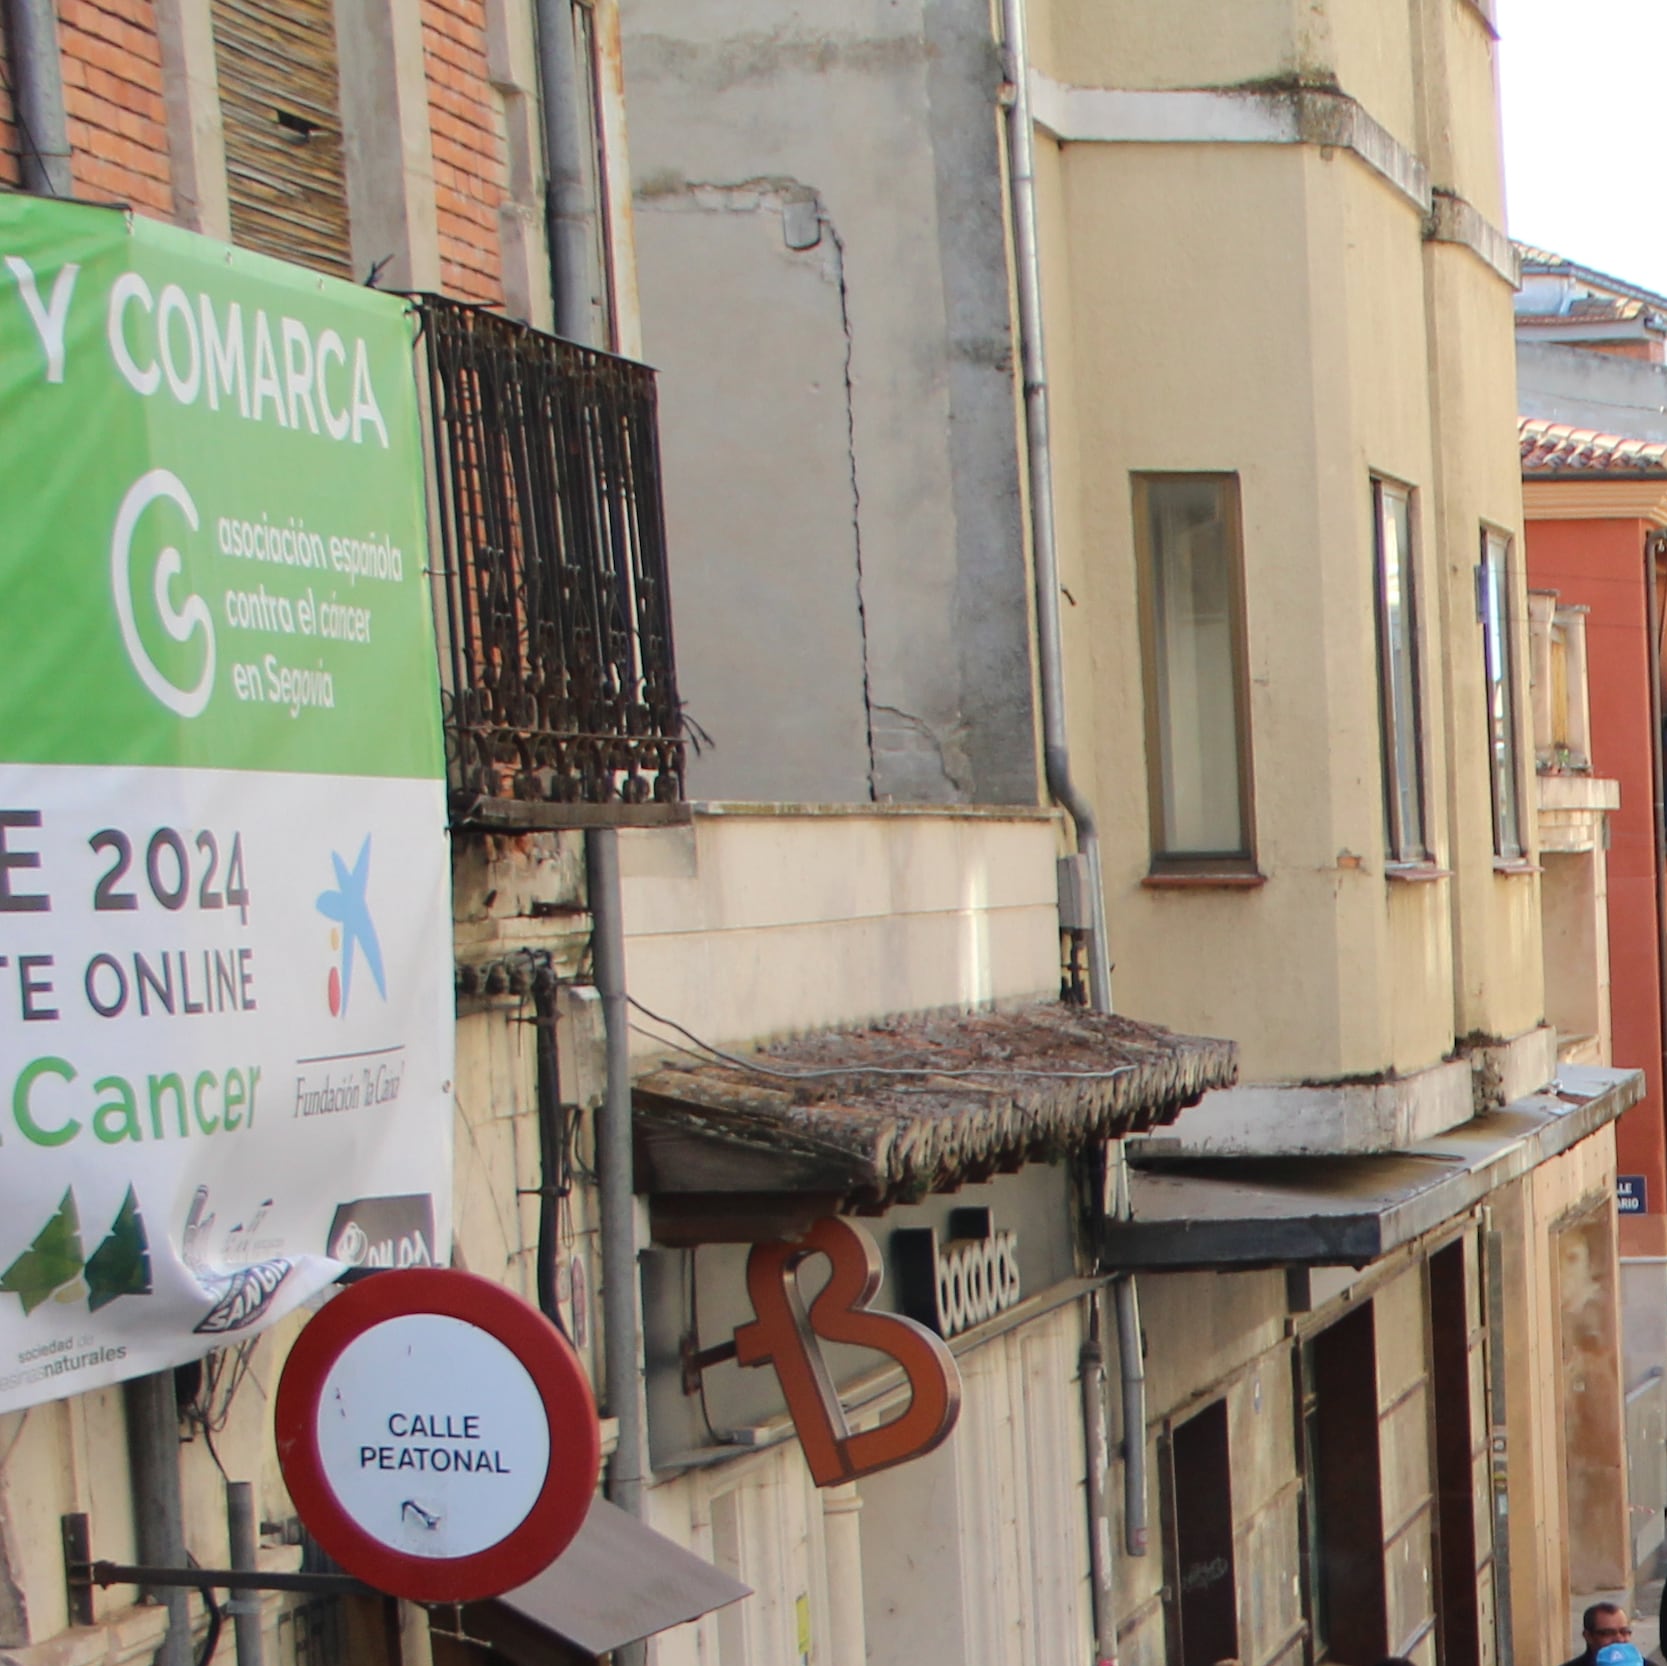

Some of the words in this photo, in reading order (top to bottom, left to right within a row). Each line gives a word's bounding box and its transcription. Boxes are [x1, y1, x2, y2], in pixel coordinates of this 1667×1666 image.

[5, 255, 80, 383] Y
[107, 270, 389, 449] COMARCA
[218, 511, 328, 569] asociación
[329, 531, 403, 587] española
[225, 583, 296, 634] contra
[297, 586, 317, 635] el
[319, 590, 371, 643] cáncer
[232, 661, 264, 702] en
[264, 652, 335, 719] Segovia
[89, 826, 250, 926] 2024
[0, 951, 60, 1022] E
[84, 947, 257, 1018] ONLINE
[294, 1073, 360, 1118] Fundación
[1616, 1182, 1633, 1196] LE
[931, 1206, 1021, 1340] bocados
[17, 1336, 73, 1364] sociedad
[387, 1412, 481, 1440] CALLE
[359, 1446, 511, 1475] PEATONAL
